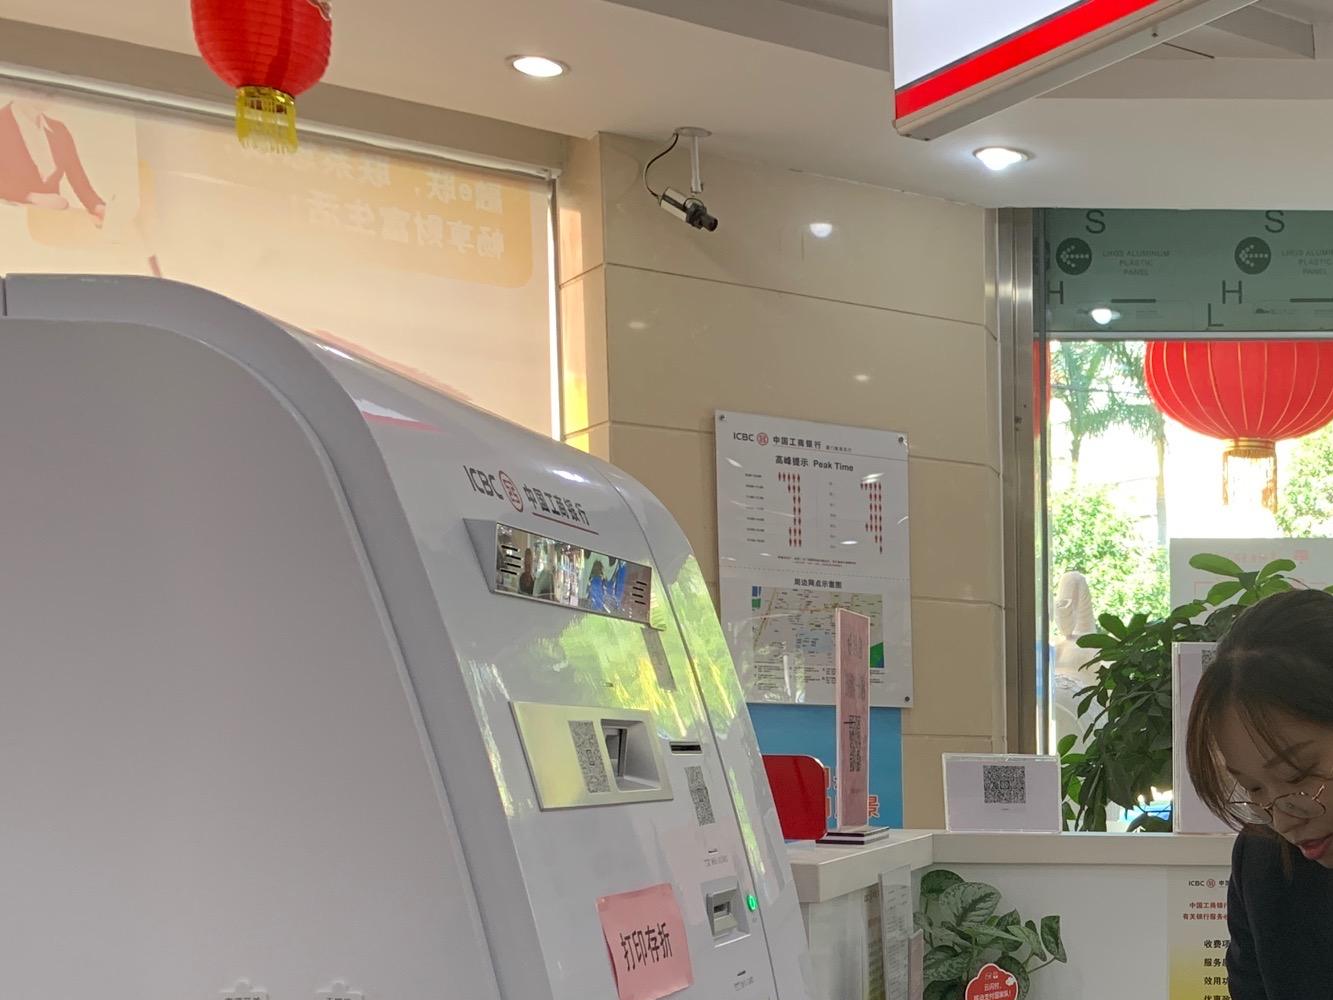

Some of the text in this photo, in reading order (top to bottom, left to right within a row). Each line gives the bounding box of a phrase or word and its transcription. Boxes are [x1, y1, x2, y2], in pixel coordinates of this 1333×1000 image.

[1221, 279, 1243, 305] H
[732, 431, 755, 443] ICBC
[772, 435, 823, 449] 中国工商银行
[774, 455, 855, 473] 高峰提示 Peak Time
[462, 464, 505, 501] ICBC
[522, 483, 591, 527] 中国工商银行
[1188, 879, 1205, 887] ICBC
[620, 921, 673, 971] 打印存折
